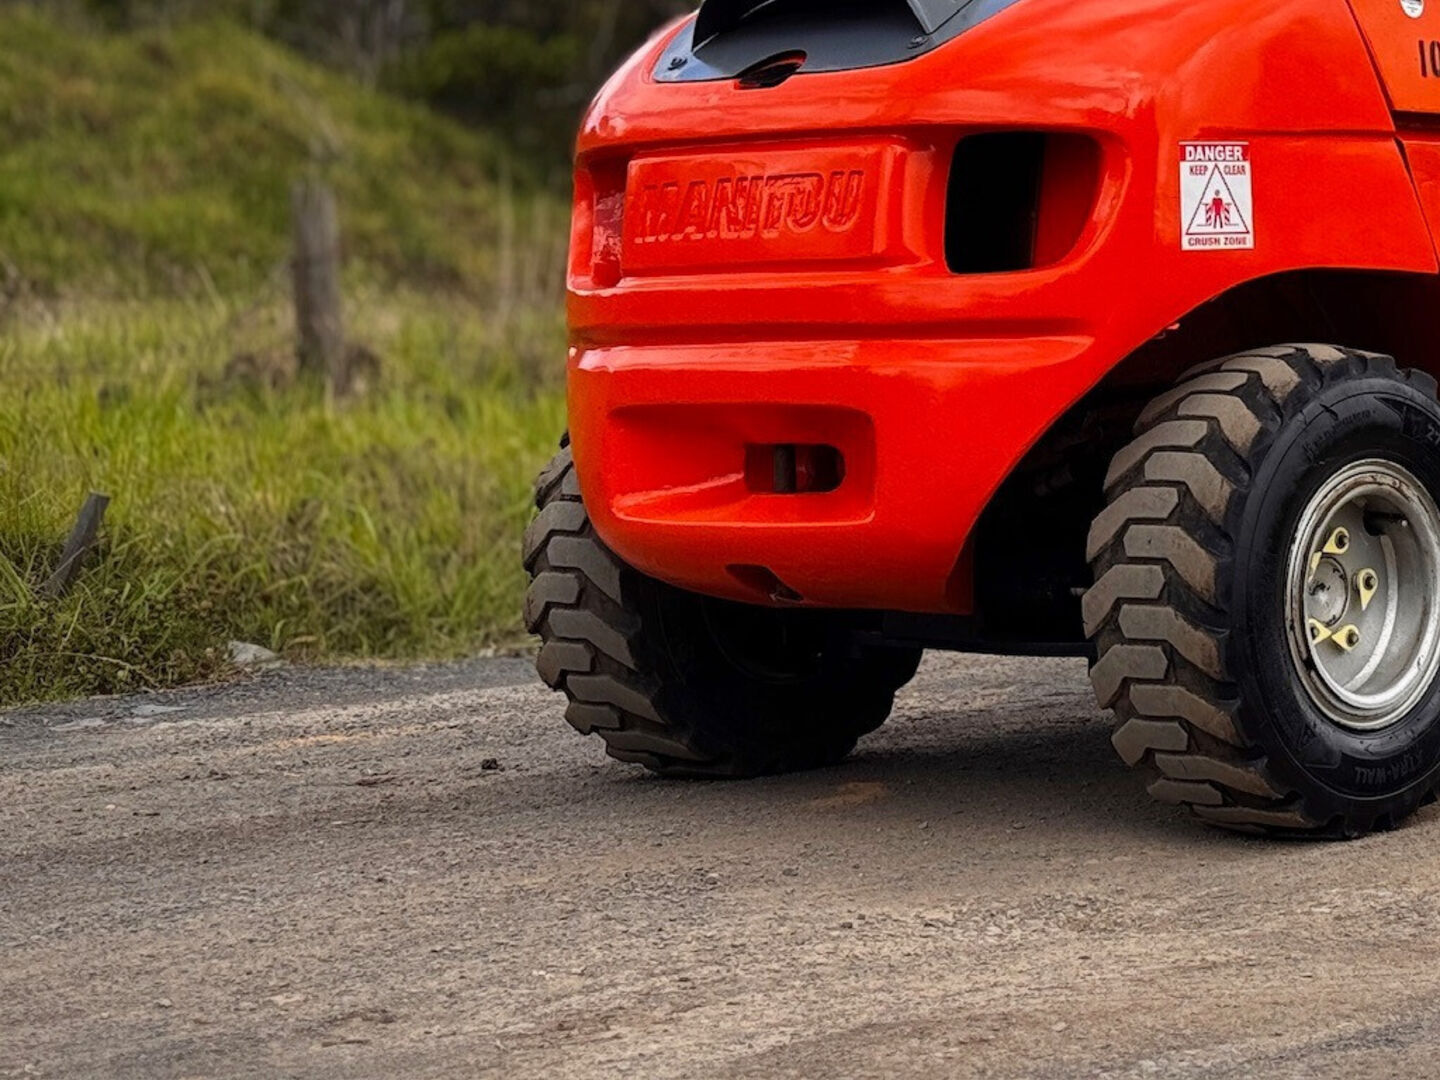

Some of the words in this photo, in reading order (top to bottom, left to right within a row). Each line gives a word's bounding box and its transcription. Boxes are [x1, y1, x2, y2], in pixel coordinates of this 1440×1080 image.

[1185, 145, 1243, 161] DANGER
[1189, 165, 1208, 176] KEEP
[1223, 165, 1246, 175] CLEAR
[634, 170, 864, 243] MANITOU
[1188, 237, 1221, 246] CRUSH
[1223, 237, 1247, 246] ZONE
